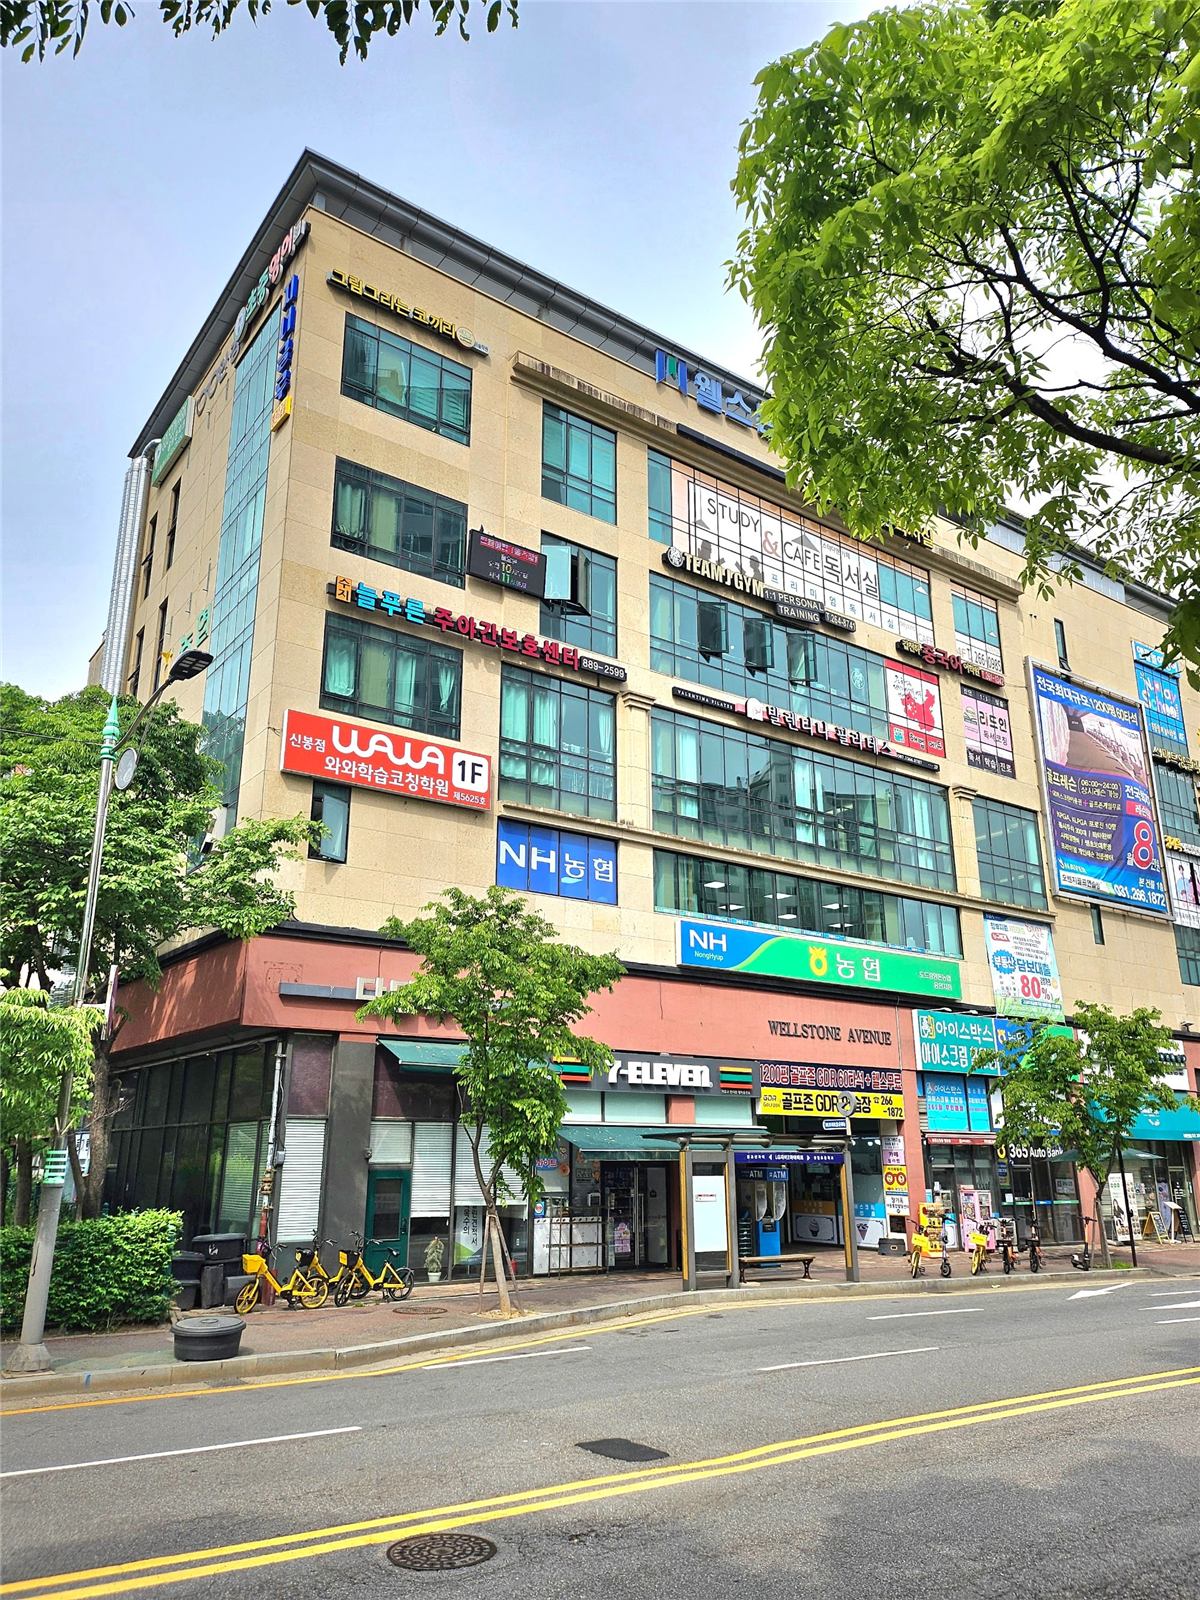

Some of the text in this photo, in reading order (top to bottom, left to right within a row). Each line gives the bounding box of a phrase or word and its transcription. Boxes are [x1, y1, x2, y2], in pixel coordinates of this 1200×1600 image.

[707, 498, 761, 533] STUDY
[763, 531, 781, 558] &
[784, 542, 822, 571] CAFE
[337, 576, 351, 602] 수지
[824, 554, 878, 598] 독서실
[778, 592, 825, 613] PERSONAL
[779, 604, 820, 622] TRAINING
[356, 582, 579, 671] 늘푸른 주야간보호센터
[581, 657, 625, 679] 889-2599
[922, 643, 963, 674] 중국어
[1036, 675, 1090, 707] 전국최대규모
[289, 732, 326, 752] 신봉점
[766, 704, 828, 741] 발렌티나
[834, 726, 897, 758] 필라테스
[332, 724, 445, 775] WAWA
[324, 756, 449, 797] 와와학습코칭학원
[456, 758, 483, 784] 1F
[1046, 767, 1077, 792] 골프레슨
[453, 791, 487, 805] 제5625호
[499, 841, 556, 873] NH
[563, 852, 614, 884] 농협
[1114, 884, 1166, 907] 031.266.1872
[688, 929, 727, 952] NH
[694, 950, 724, 962] NongHyup
[836, 953, 881, 982] 농협
[1016, 958, 1051, 977] 담보대출
[768, 1020, 892, 1046] WELLSTONE AVENUE
[935, 1020, 994, 1045] 아이스박스
[921, 1042, 968, 1068] 아이스크림
[760, 1063, 789, 1084] 1200평
[790, 1065, 816, 1086] 골프존
[816, 1068, 838, 1088] GDR
[871, 1071, 903, 1091] 헬스무료
[782, 1092, 814, 1112] 골프존
[880, 1095, 893, 1106] 266
[883, 1107, 903, 1118] -1872
[1009, 1143, 1029, 1158] 365
[1029, 1147, 1046, 1159] Auto
[749, 1170, 763, 1179] ATM
[773, 1170, 786, 1179] ATM
